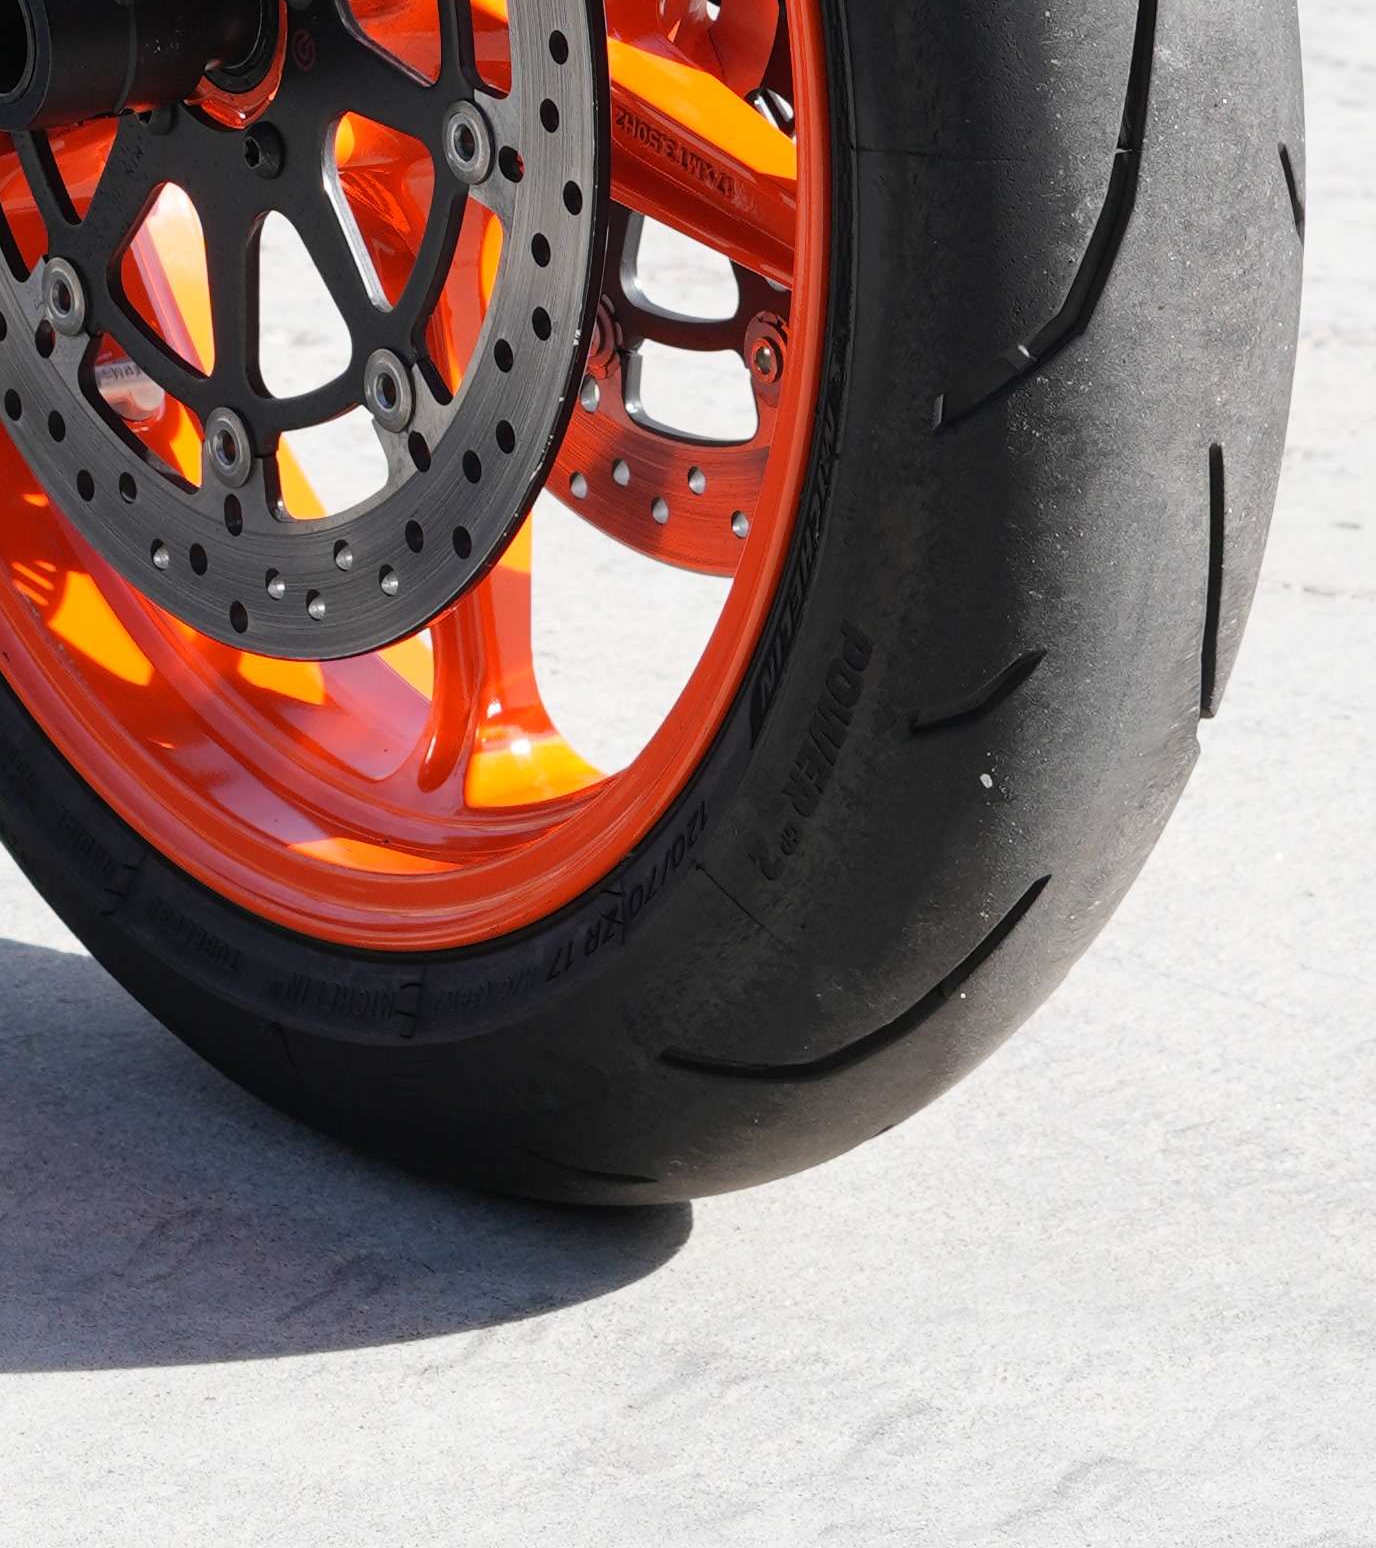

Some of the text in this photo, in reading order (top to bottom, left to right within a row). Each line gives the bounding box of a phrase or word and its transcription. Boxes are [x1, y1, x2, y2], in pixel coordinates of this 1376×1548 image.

[780, 618, 874, 819] POWER
[628, 799, 709, 920] 120/70
[749, 830, 785, 882] 2
[546, 939, 575, 983] 17
